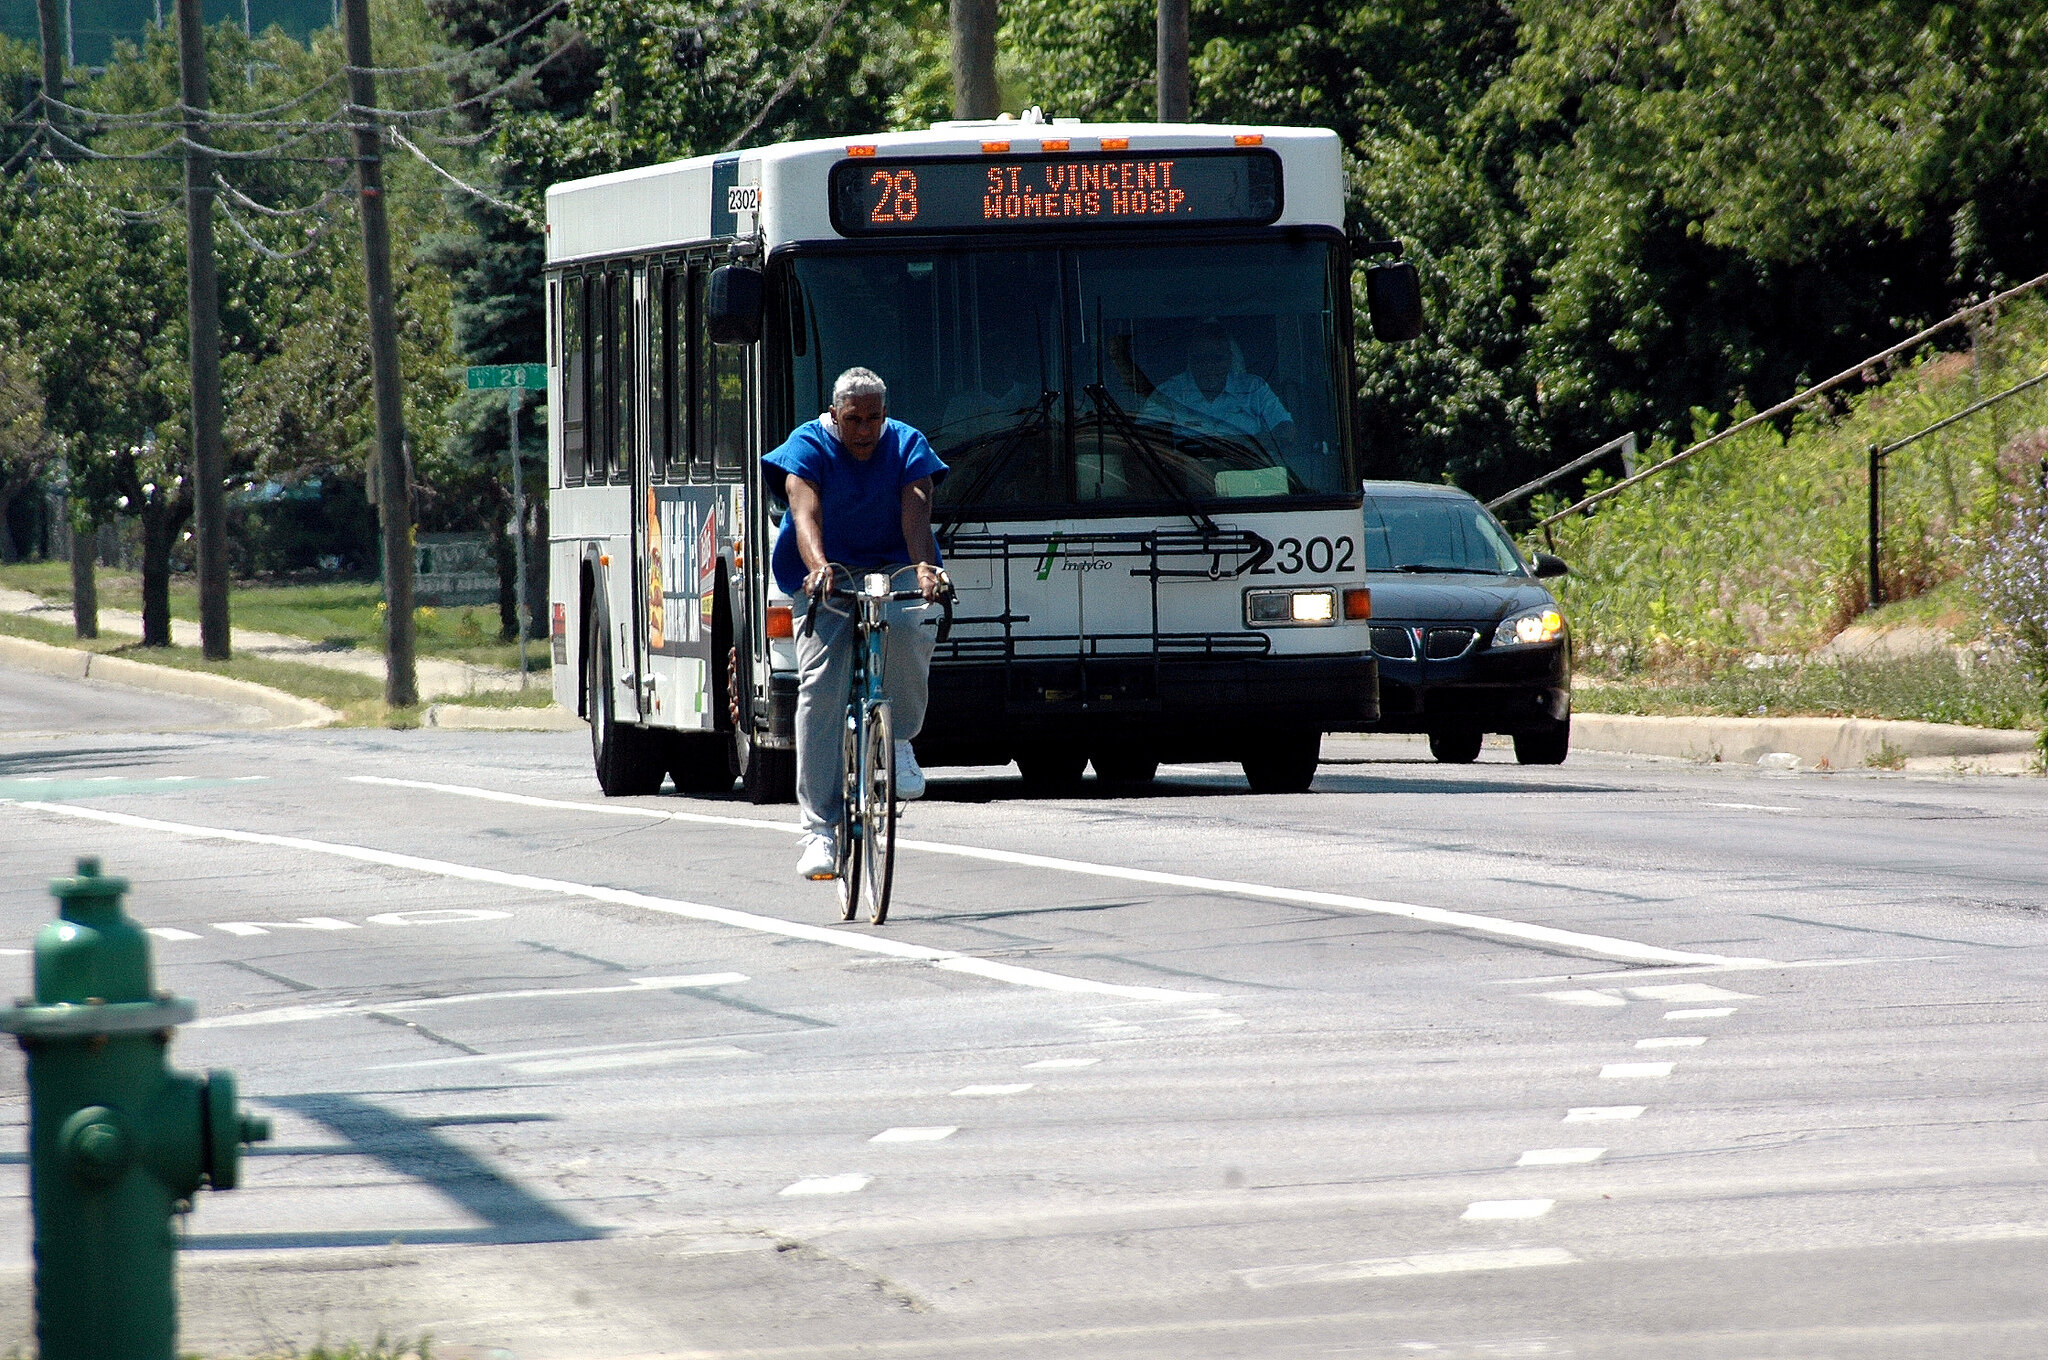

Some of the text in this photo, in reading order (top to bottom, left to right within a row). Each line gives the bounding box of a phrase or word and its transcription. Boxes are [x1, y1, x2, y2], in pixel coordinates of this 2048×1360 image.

[870, 168, 918, 222] 28
[987, 161, 1175, 195] ST. VINCENT
[729, 189, 756, 210] 2302
[983, 189, 1193, 219] WOMENS HOSP.
[1249, 535, 1356, 575] 2302
